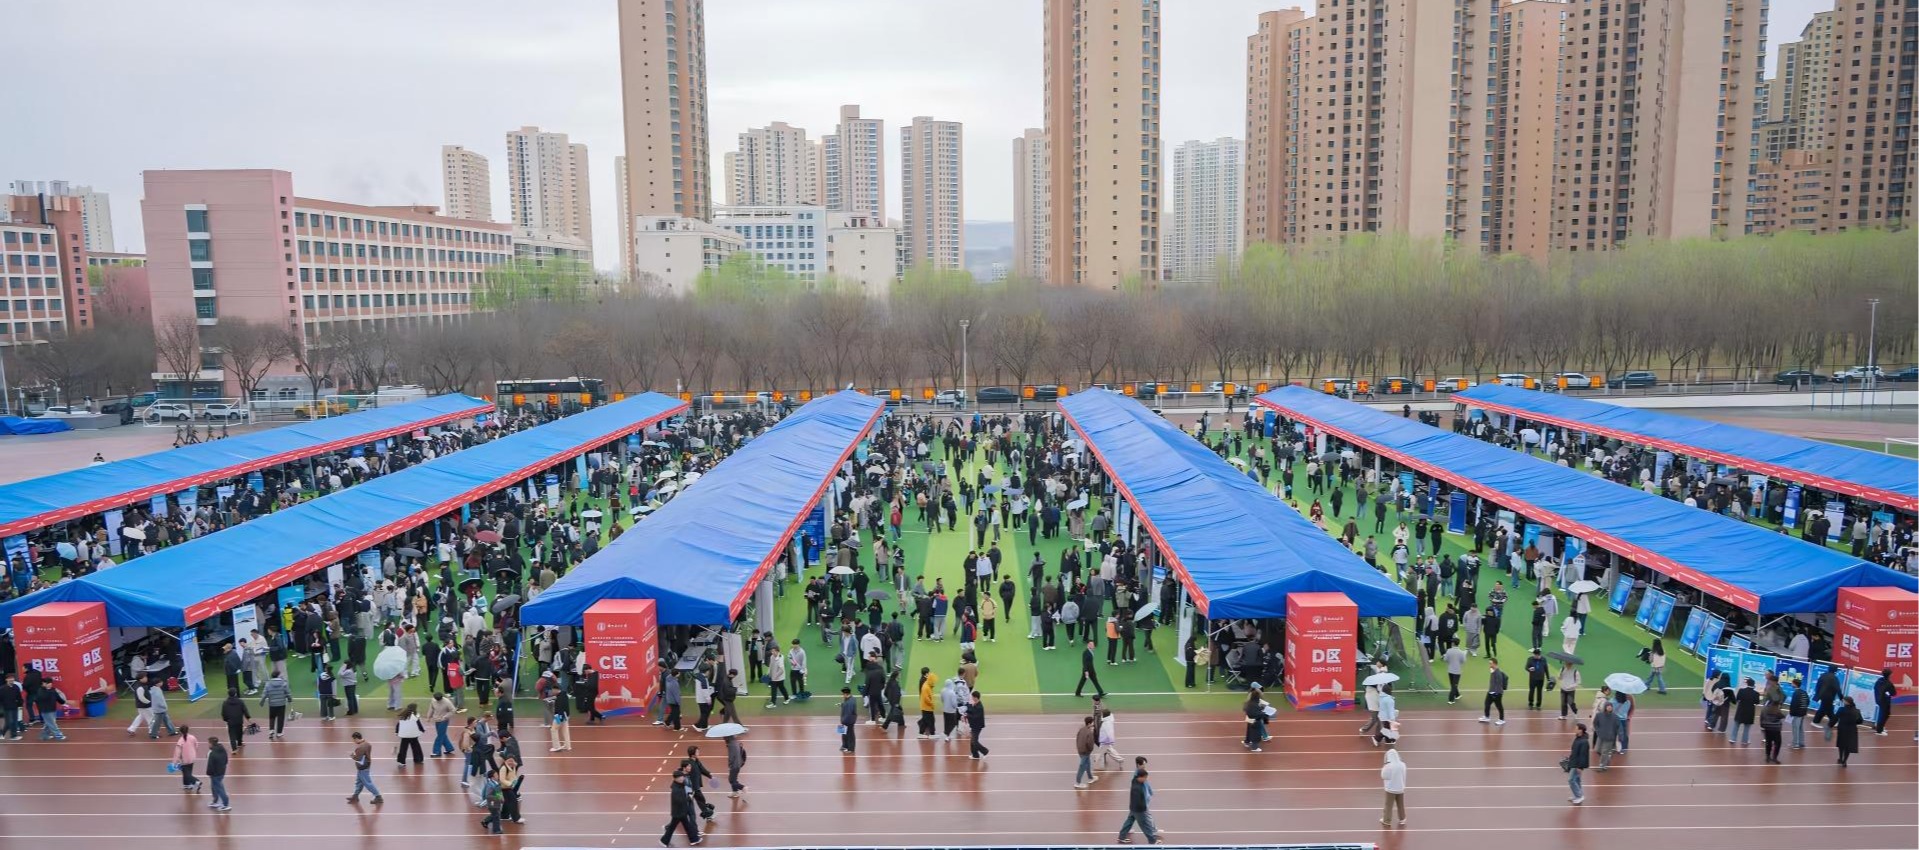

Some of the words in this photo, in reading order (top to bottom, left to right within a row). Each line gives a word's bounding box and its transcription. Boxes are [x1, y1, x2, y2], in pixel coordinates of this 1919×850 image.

[1842, 633, 1860, 653] E区
[1886, 643, 1913, 658] E区
[82, 647, 102, 667] B区
[598, 655, 628, 670] C区
[1312, 648, 1341, 664] D区
